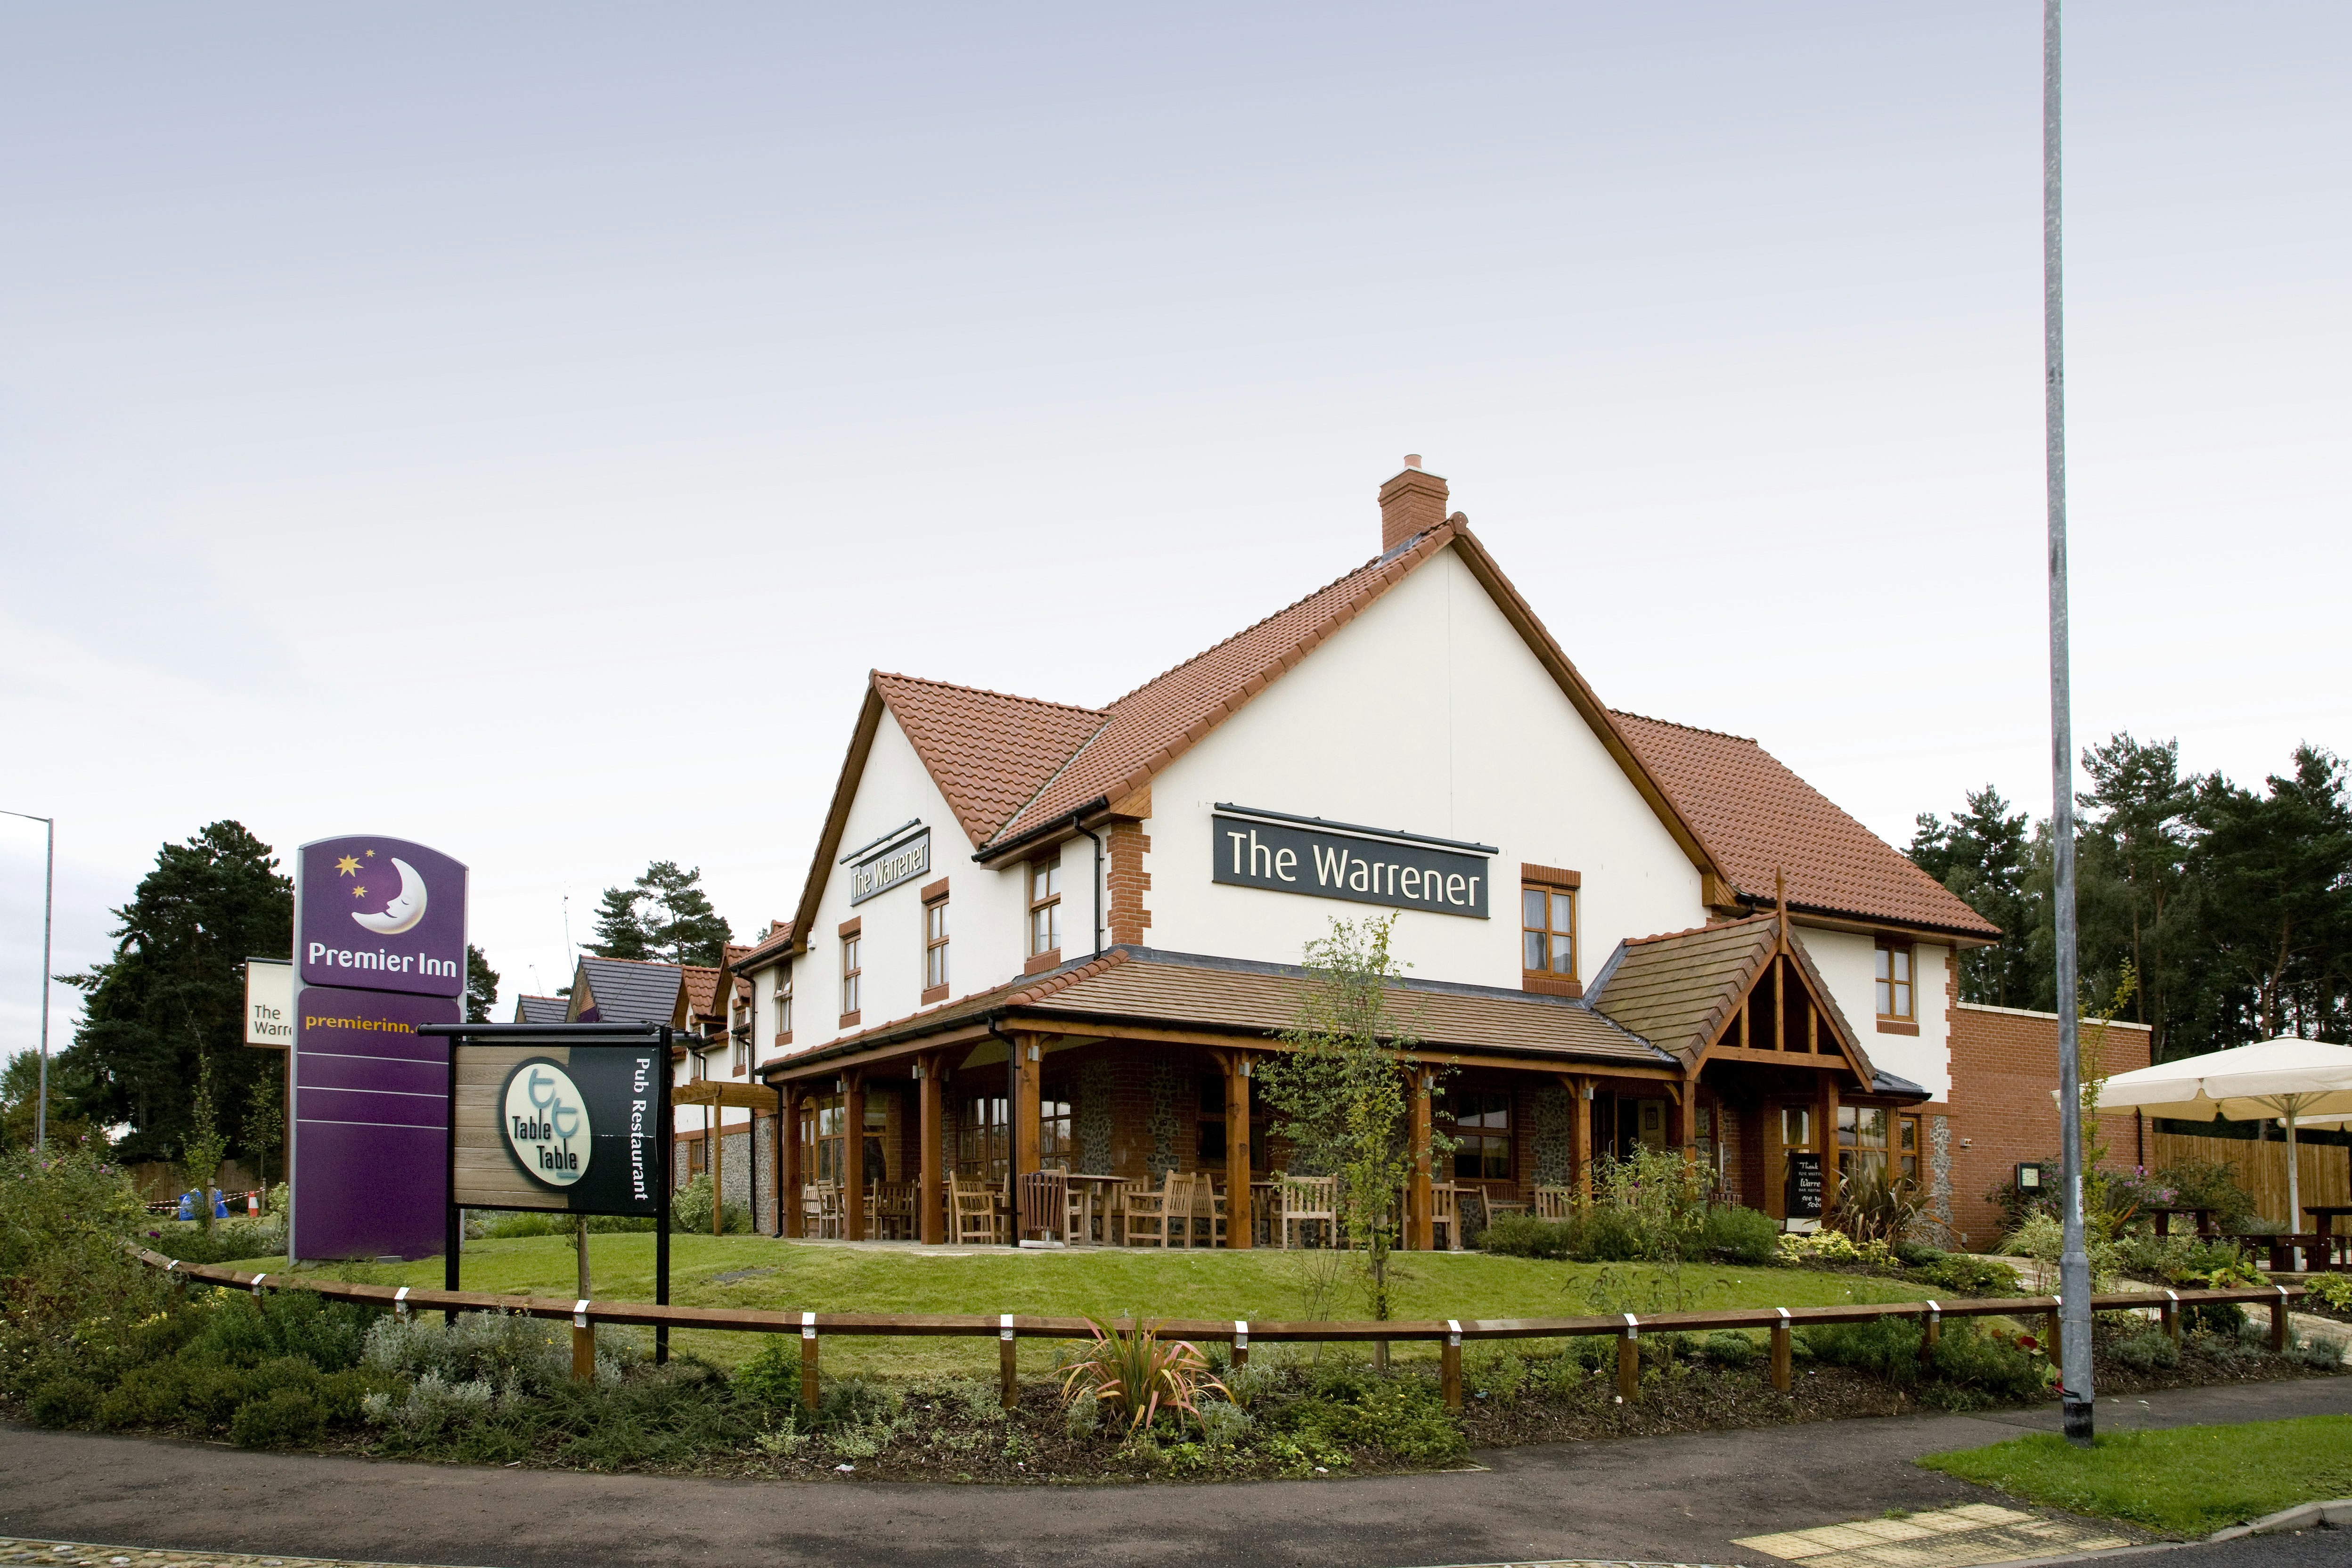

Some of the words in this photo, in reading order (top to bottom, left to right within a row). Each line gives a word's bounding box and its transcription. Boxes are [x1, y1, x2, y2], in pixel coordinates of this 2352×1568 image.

[852, 868, 872, 898] The
[874, 844, 926, 888] Warrener
[1227, 829, 1297, 882] The
[1313, 844, 1480, 906] Warrener
[309, 942, 414, 972] Premier
[419, 953, 456, 978] Inn
[255, 1004, 280, 1020] The
[306, 1015, 418, 1034] premierinn.
[634, 1058, 650, 1093] Pub
[512, 1109, 551, 1140] Table
[537, 1138, 577, 1169] Table
[631, 1100, 648, 1200] Restaurant
[1799, 1161, 1819, 1169] Thank
[1800, 1178, 1821, 1187] Warre
